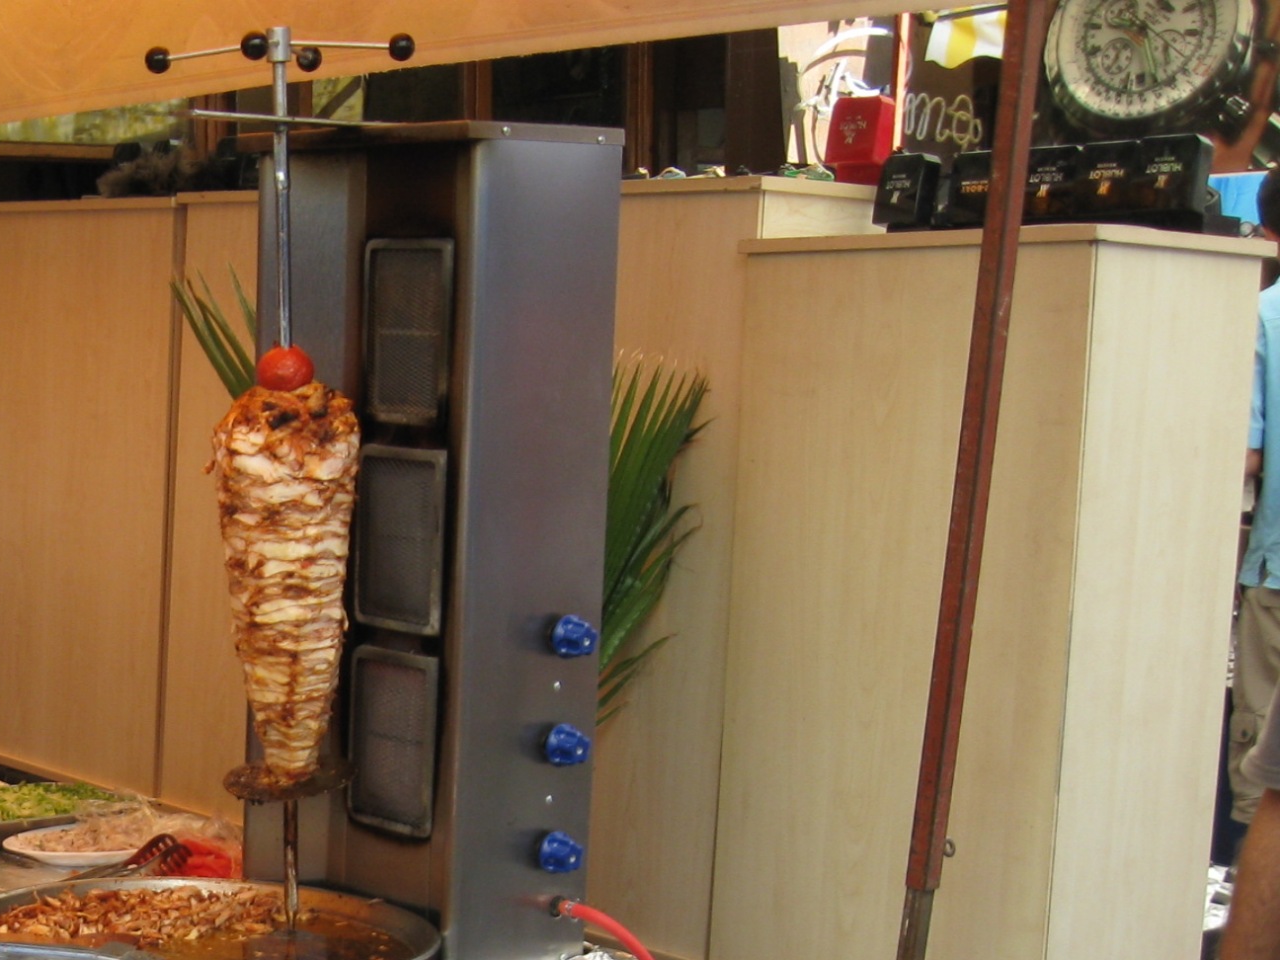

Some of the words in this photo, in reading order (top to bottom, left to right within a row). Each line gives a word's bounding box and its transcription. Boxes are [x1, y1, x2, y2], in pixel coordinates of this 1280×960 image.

[1145, 162, 1184, 174] HUBLOT
[1029, 172, 1064, 183] HUBLOT
[1088, 169, 1125, 180] HUBLOT
